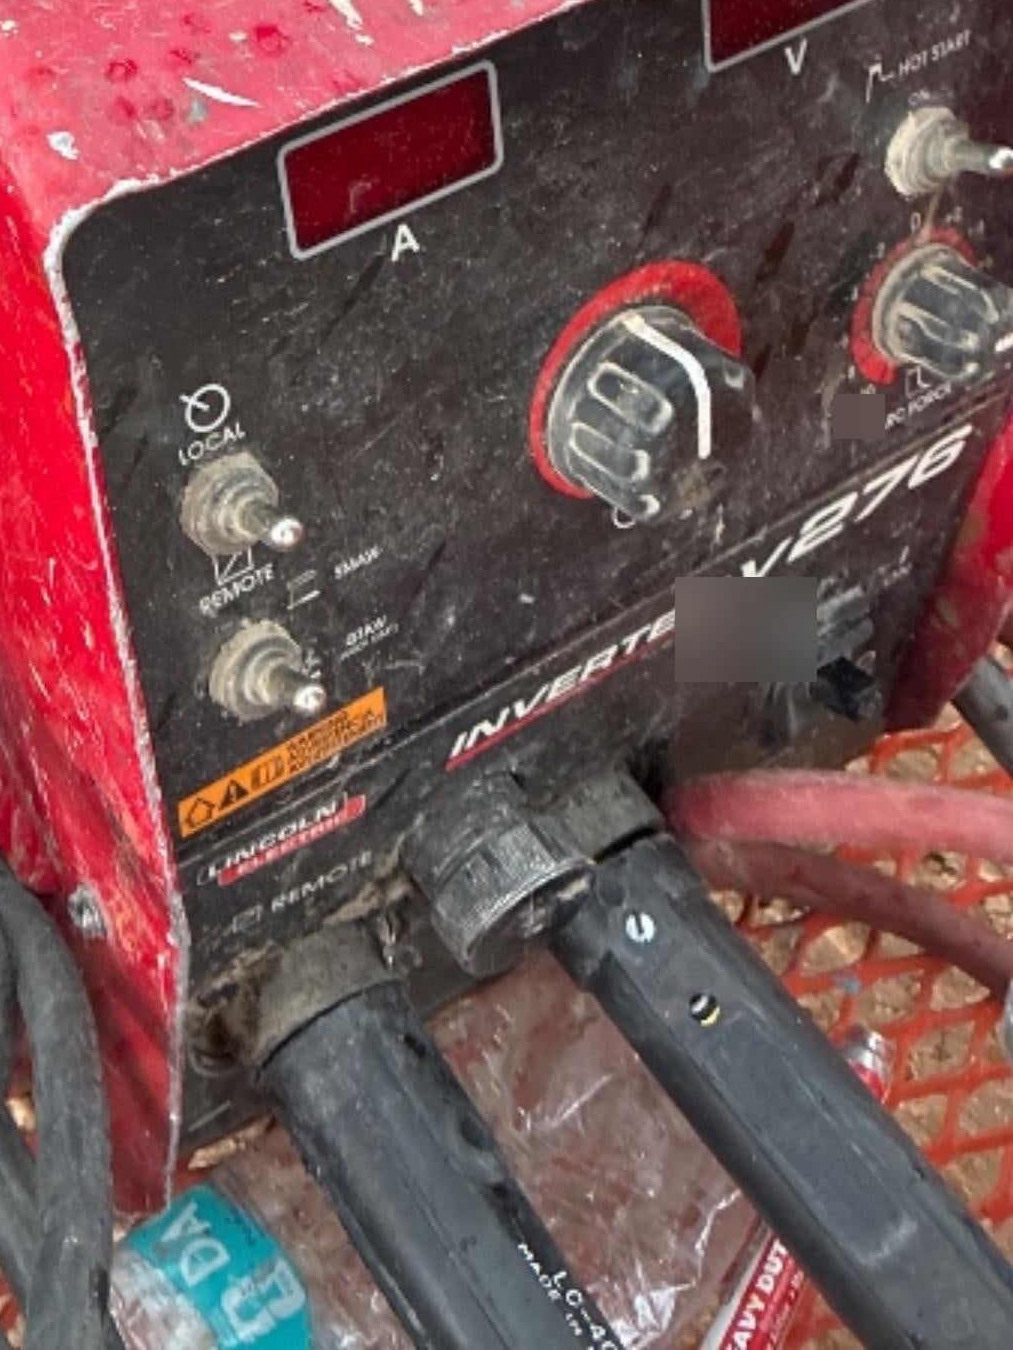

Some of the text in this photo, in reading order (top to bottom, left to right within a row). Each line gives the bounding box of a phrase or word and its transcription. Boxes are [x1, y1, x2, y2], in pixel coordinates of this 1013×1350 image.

[784, 38, 808, 76] V
[931, 29, 972, 62] START
[390, 223, 421, 262] A
[178, 421, 246, 466] LOCAL
[199, 562, 276, 617] REMOTE
[450, 607, 677, 758] INVERTE
[207, 799, 337, 879] LINCOLN
[756, 1237, 791, 1291] DUT
